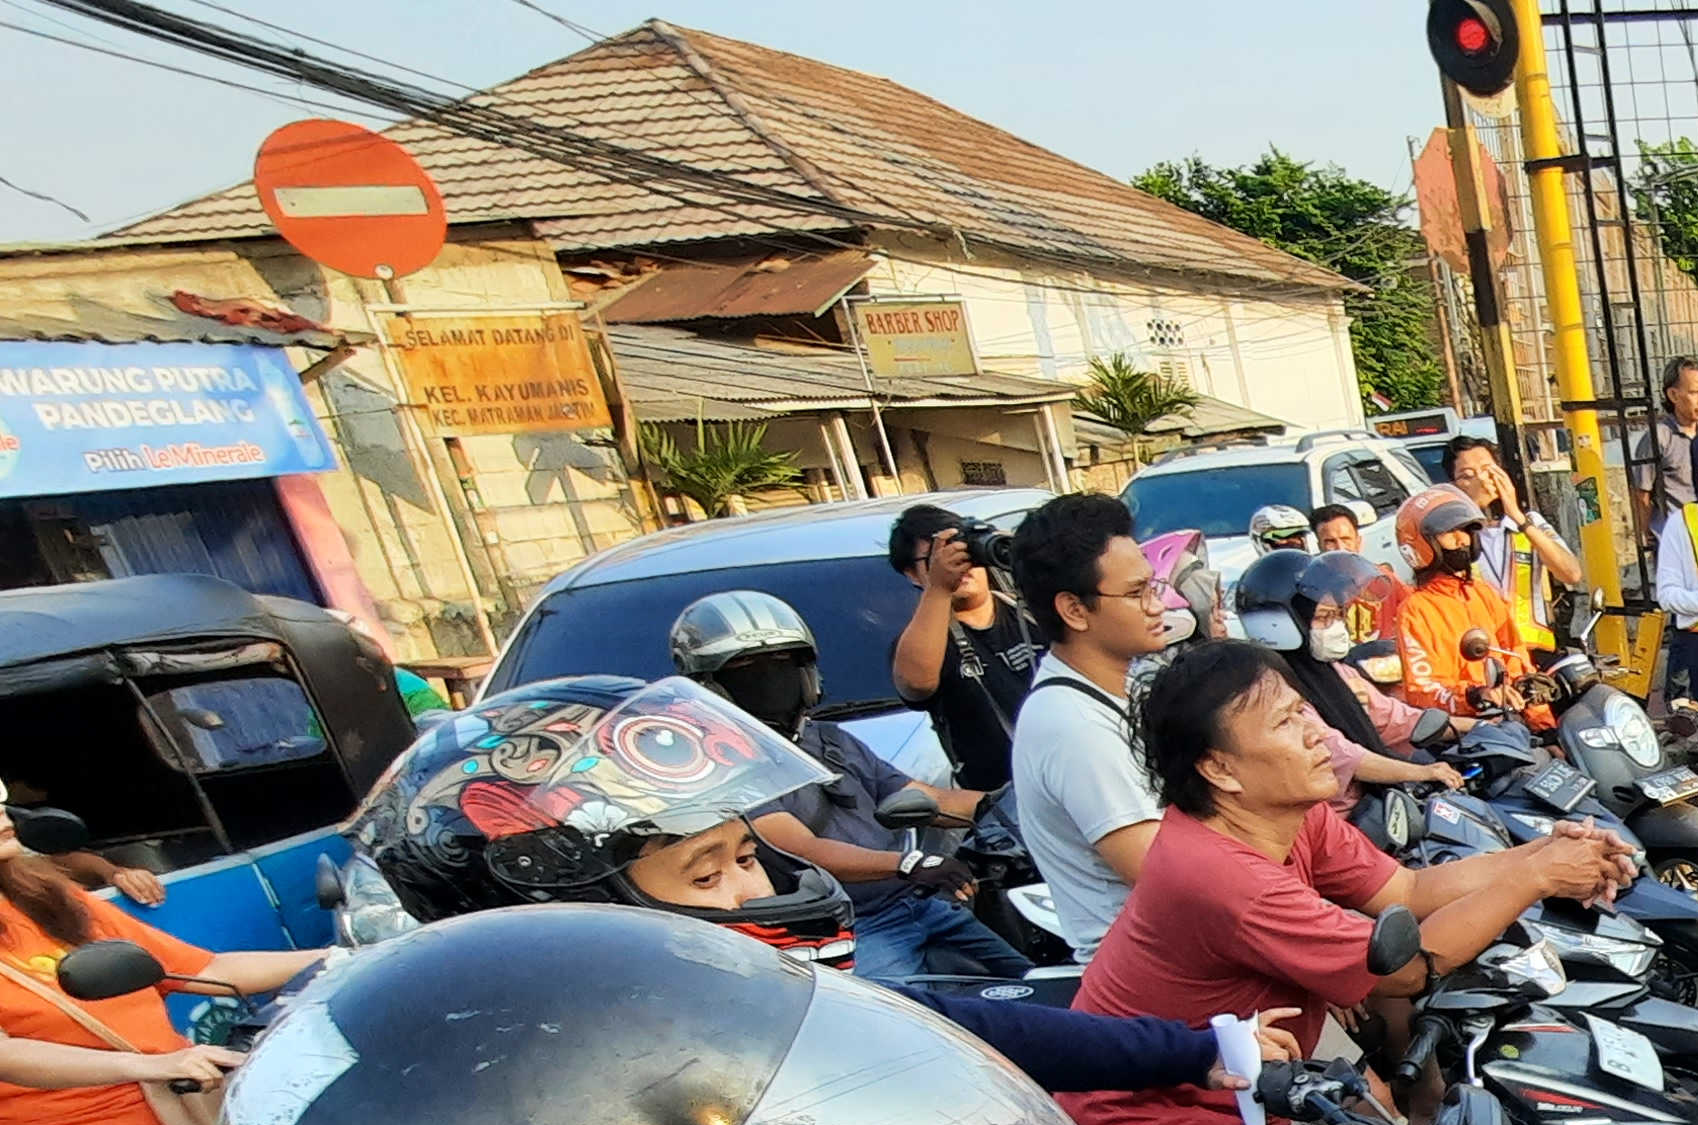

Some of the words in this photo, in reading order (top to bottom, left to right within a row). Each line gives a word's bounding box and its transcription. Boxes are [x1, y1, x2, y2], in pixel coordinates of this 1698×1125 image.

[865, 312, 923, 334] BARBER
[924, 310, 960, 333] SHOP
[405, 329, 487, 349] SELAMAT
[493, 326, 555, 346] DATANG
[560, 324, 573, 341] DI
[0, 367, 153, 396] WARUNG
[153, 366, 257, 392] PUTRA
[424, 386, 471, 405] KEL.
[33, 400, 256, 430] PANDEGLANG
[84, 449, 147, 473] Pilih
[171, 440, 266, 467] Minerale
